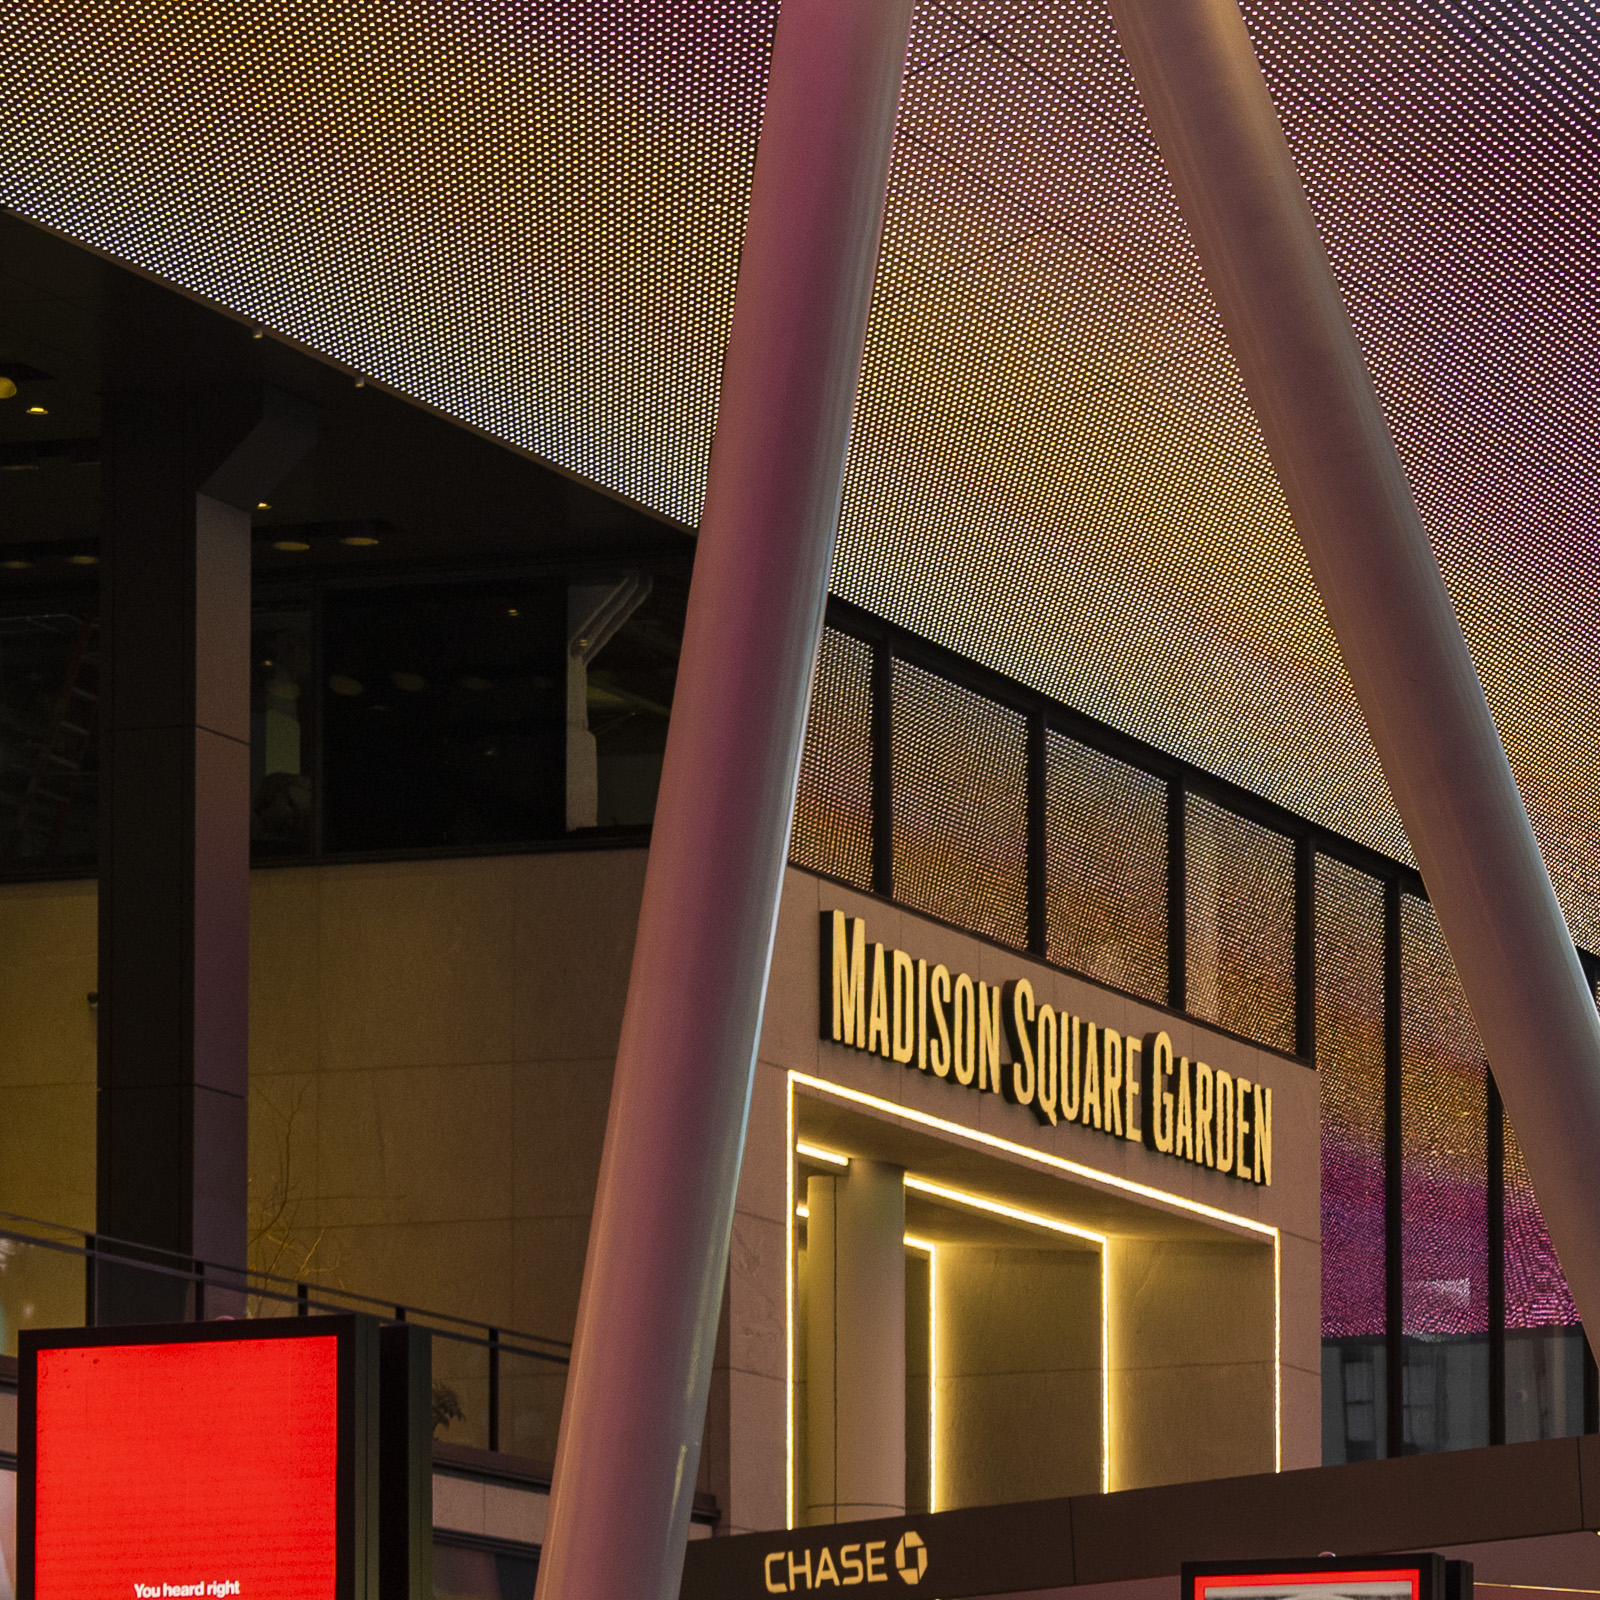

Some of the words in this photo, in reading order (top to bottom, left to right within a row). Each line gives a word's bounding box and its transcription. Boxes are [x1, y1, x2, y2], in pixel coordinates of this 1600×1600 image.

[832, 908, 1001, 1095] MADISON
[1011, 977, 1143, 1145] SQUARE
[1151, 1030, 1274, 1188] GARDEN
[134, 1583, 162, 1599] You
[162, 1580, 205, 1598] heard
[206, 1579, 240, 1599] right
[764, 1540, 889, 1595] CHASE
